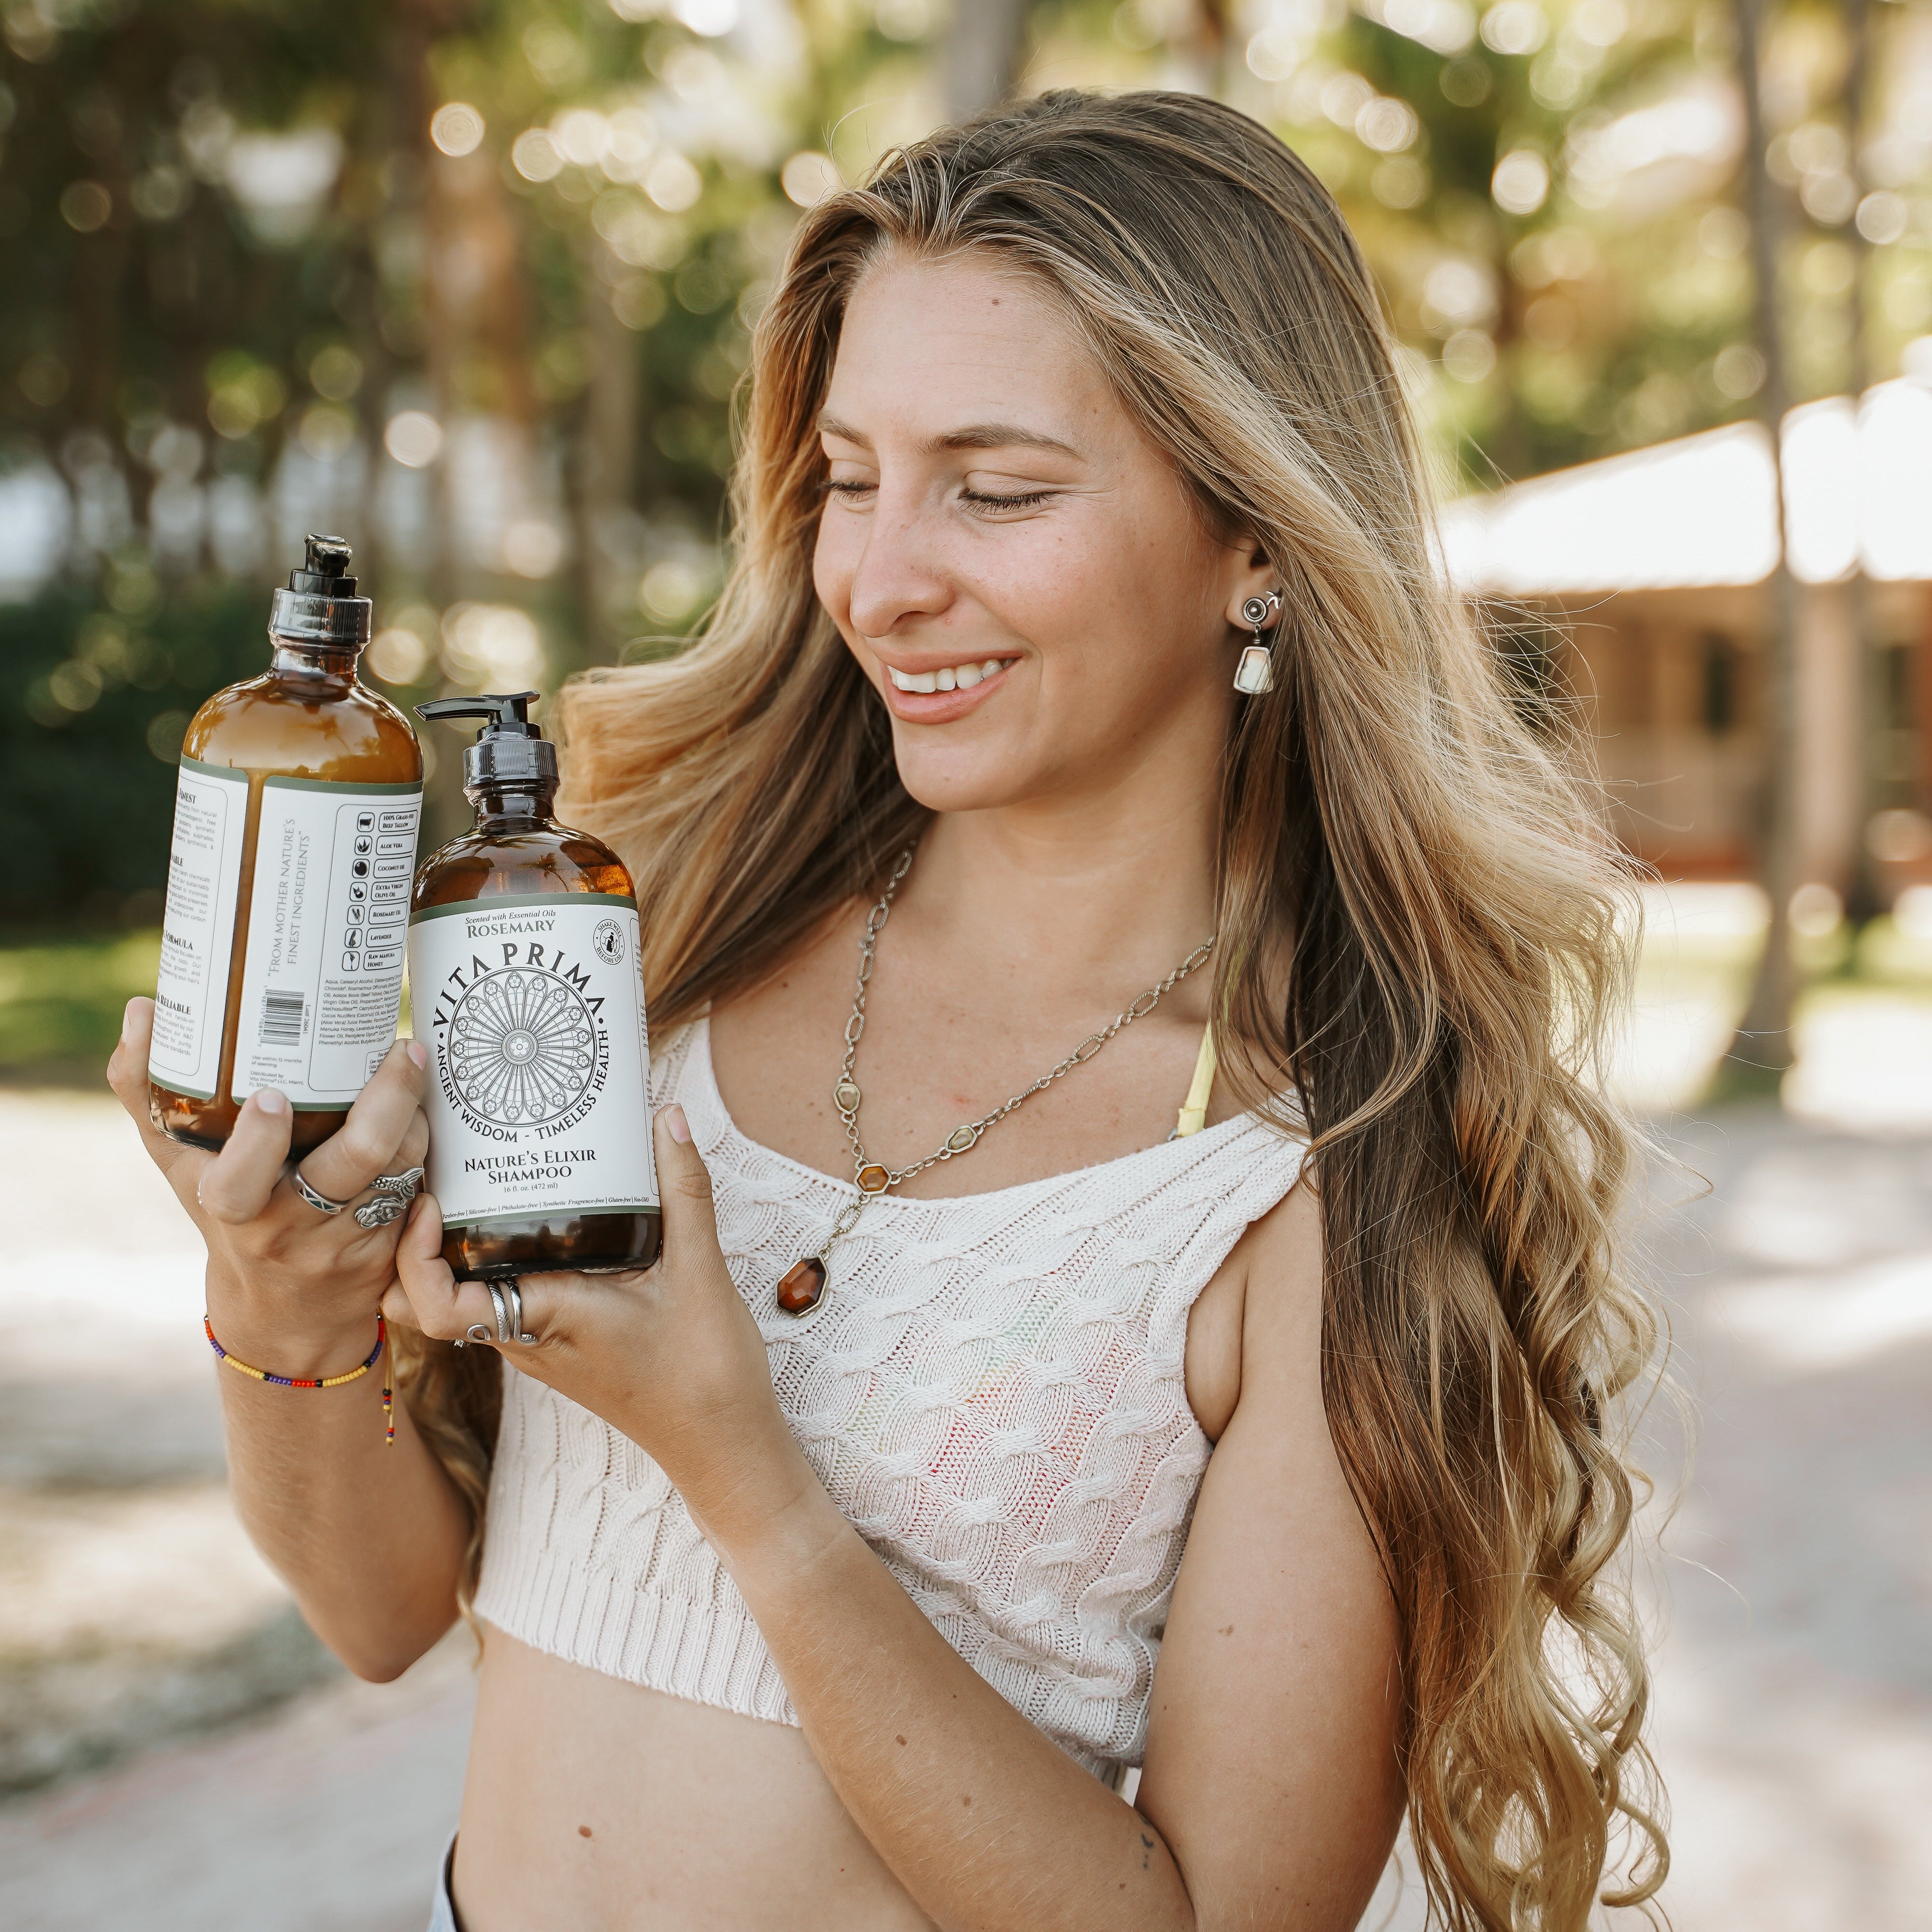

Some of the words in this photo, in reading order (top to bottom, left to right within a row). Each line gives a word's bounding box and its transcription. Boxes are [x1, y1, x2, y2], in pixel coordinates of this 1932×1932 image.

[196, 825, 215, 834] synthetic
[189, 873, 211, 882] chemicals
[188, 898, 208, 907] preserves
[275, 881, 289, 935] MOTHER
[465, 915, 490, 924] Scented
[509, 910, 540, 919] Essential
[467, 920, 555, 938] ROSEMARY
[597, 922, 612, 932] SHAKE
[613, 923, 622, 938] WELL
[165, 930, 193, 950] FORMULA
[287, 923, 300, 965] FINEST
[597, 947, 614, 963] BEFORE
[433, 954, 492, 1028] VITA
[501, 942, 605, 1017] PRIMA
[160, 994, 192, 1015] RELIABLE
[175, 1014, 195, 1024] hands-on
[437, 1044, 462, 1111] ANCIENT
[461, 1108, 518, 1143] WISDOM
[535, 1094, 597, 1140] TIMELESS
[593, 1029, 610, 1092] HEALTH
[465, 1151, 539, 1173] NATURE’S
[544, 1149, 597, 1164] ELIXIR
[488, 1165, 572, 1184] SHAMPOO
[469, 1207, 497, 1215] Silicone-free
[501, 1201, 538, 1211] Phthalate-free
[568, 1197, 605, 1206] Fragrence-free
